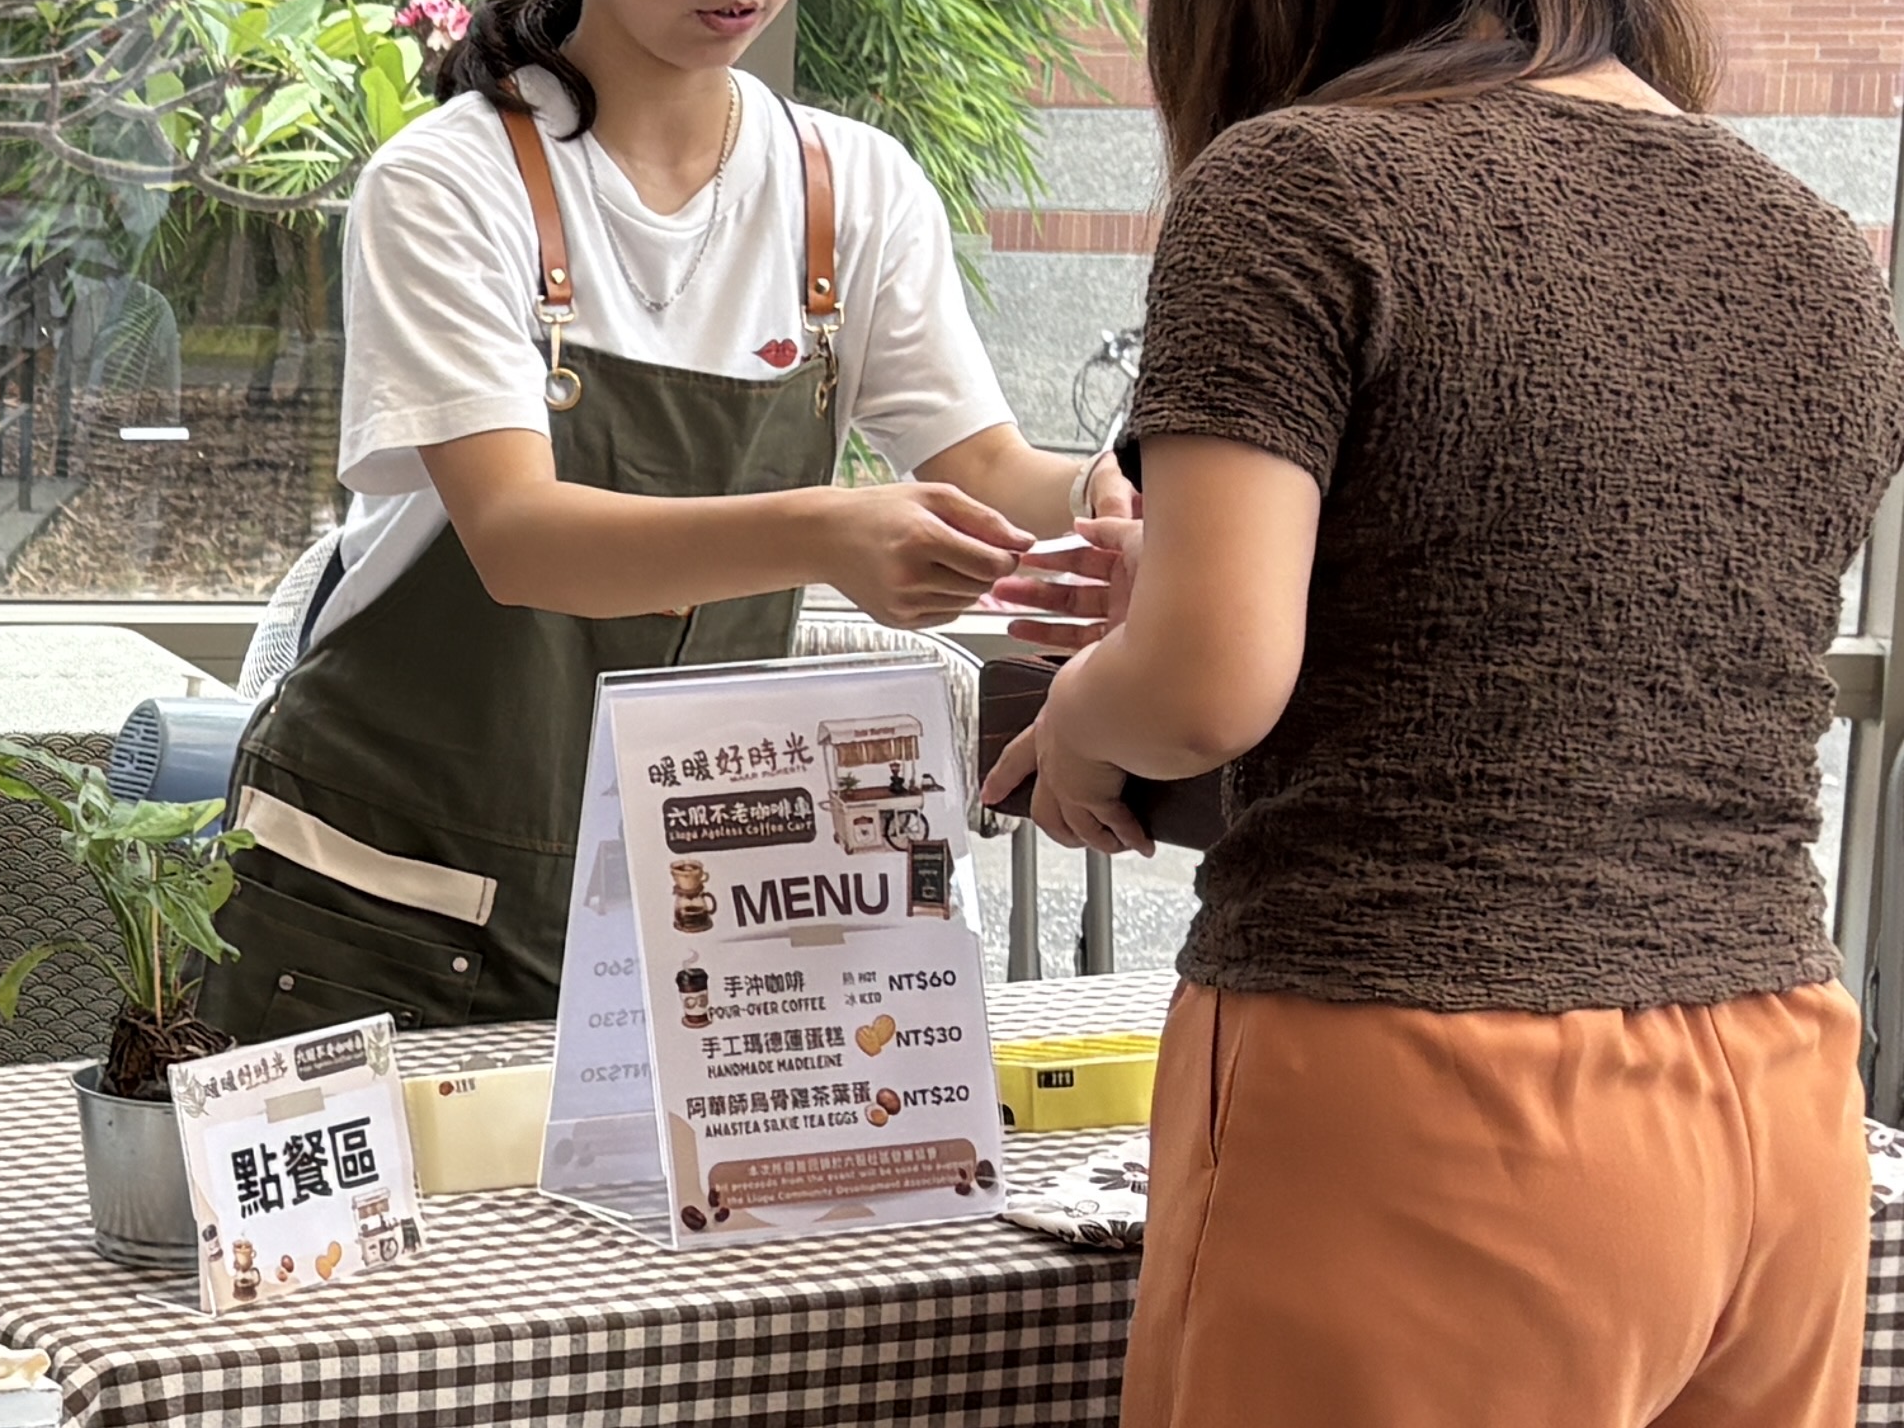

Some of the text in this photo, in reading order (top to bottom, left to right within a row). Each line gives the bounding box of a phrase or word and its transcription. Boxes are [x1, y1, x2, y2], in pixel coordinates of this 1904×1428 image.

[648, 732, 814, 787] 暖暖好時光
[731, 873, 889, 927] MENU
[724, 971, 805, 998] 手沖咖啡
[889, 970, 957, 992] NT$60
[782, 996, 826, 1015] COFFEE
[895, 1026, 962, 1048] NT$30
[903, 1085, 970, 1107] NT$20
[803, 1113, 825, 1128] TEA
[231, 1116, 379, 1219] 點餐區
